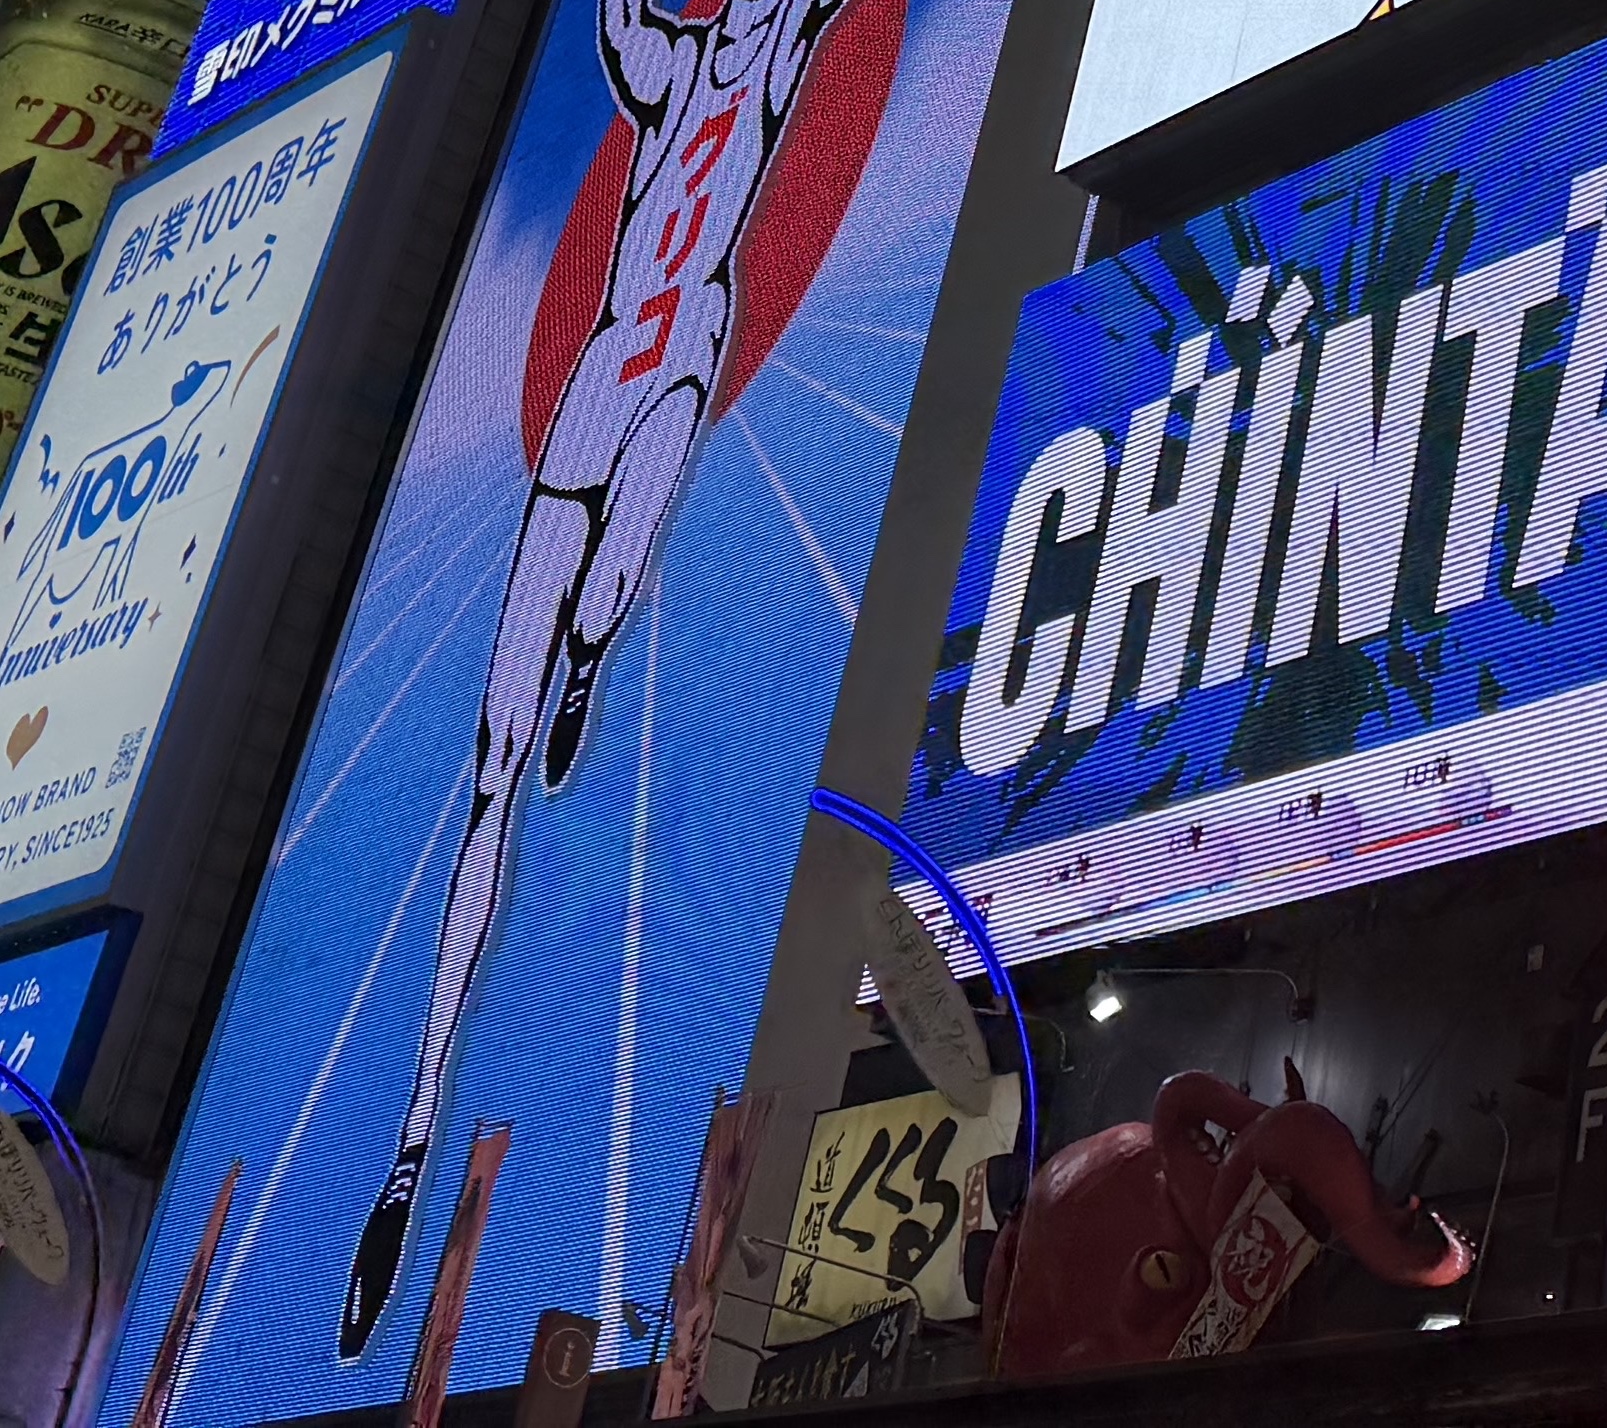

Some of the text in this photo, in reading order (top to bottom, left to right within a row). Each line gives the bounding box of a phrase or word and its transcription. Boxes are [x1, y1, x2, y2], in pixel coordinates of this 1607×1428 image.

[103, 117, 347, 297] 創業100周年
[617, 85, 750, 384] グリコ
[97, 233, 278, 375] ありがとう
[22, 807, 116, 865] SINCE1925
[33, 766, 97, 820] BRAND
